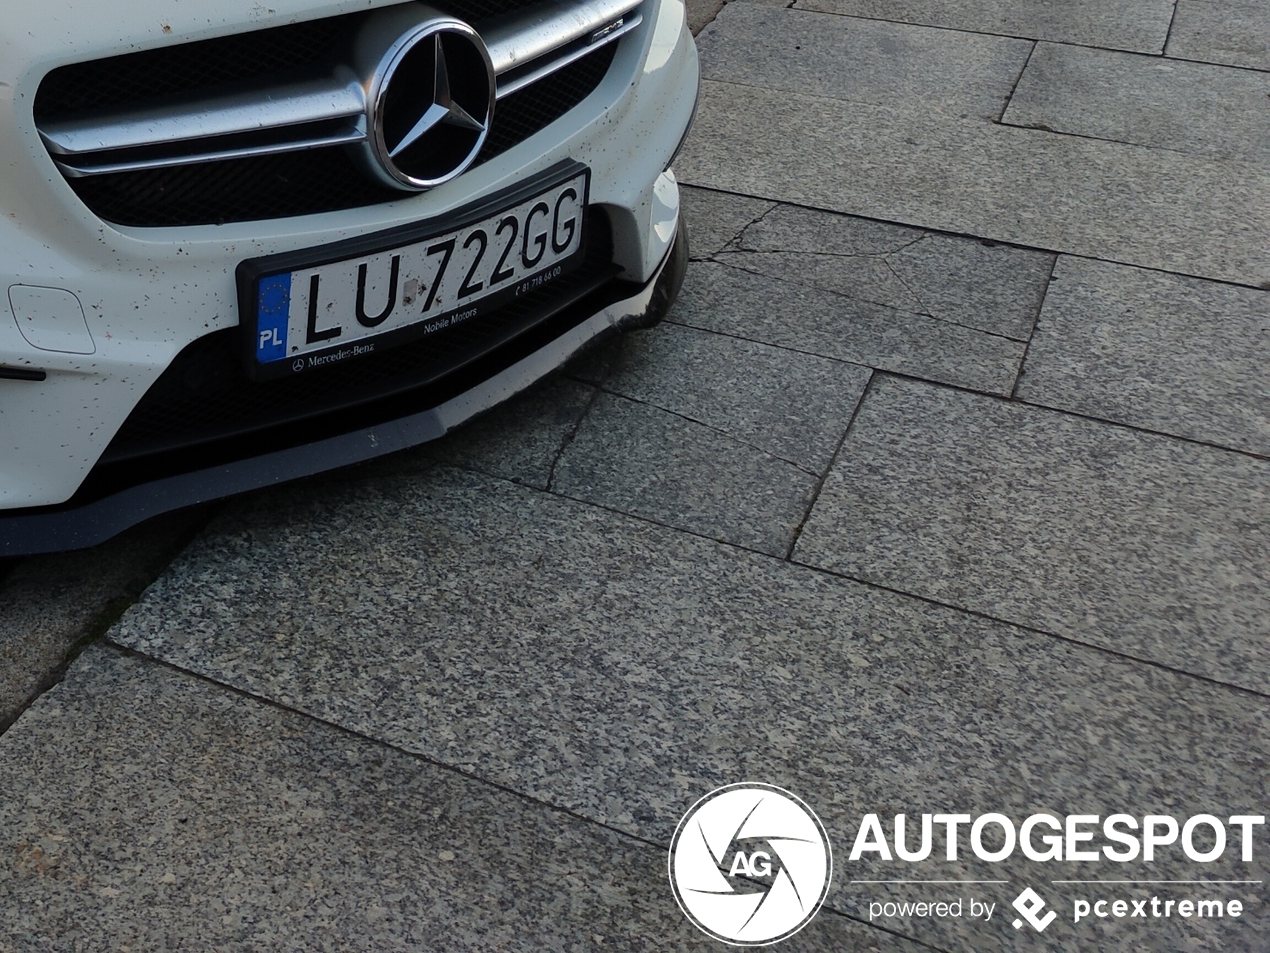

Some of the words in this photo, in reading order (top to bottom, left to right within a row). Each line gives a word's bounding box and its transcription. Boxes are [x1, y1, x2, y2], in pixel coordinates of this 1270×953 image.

[306, 255, 401, 345] LU
[421, 187, 578, 314] 722GG
[522, 283, 530, 293] 81
[531, 276, 543, 288] 718
[423, 318, 450, 335] Nobile
[450, 306, 478, 327] Motors
[259, 330, 283, 349] PL
[307, 343, 375, 368] Mercedes-Benz
